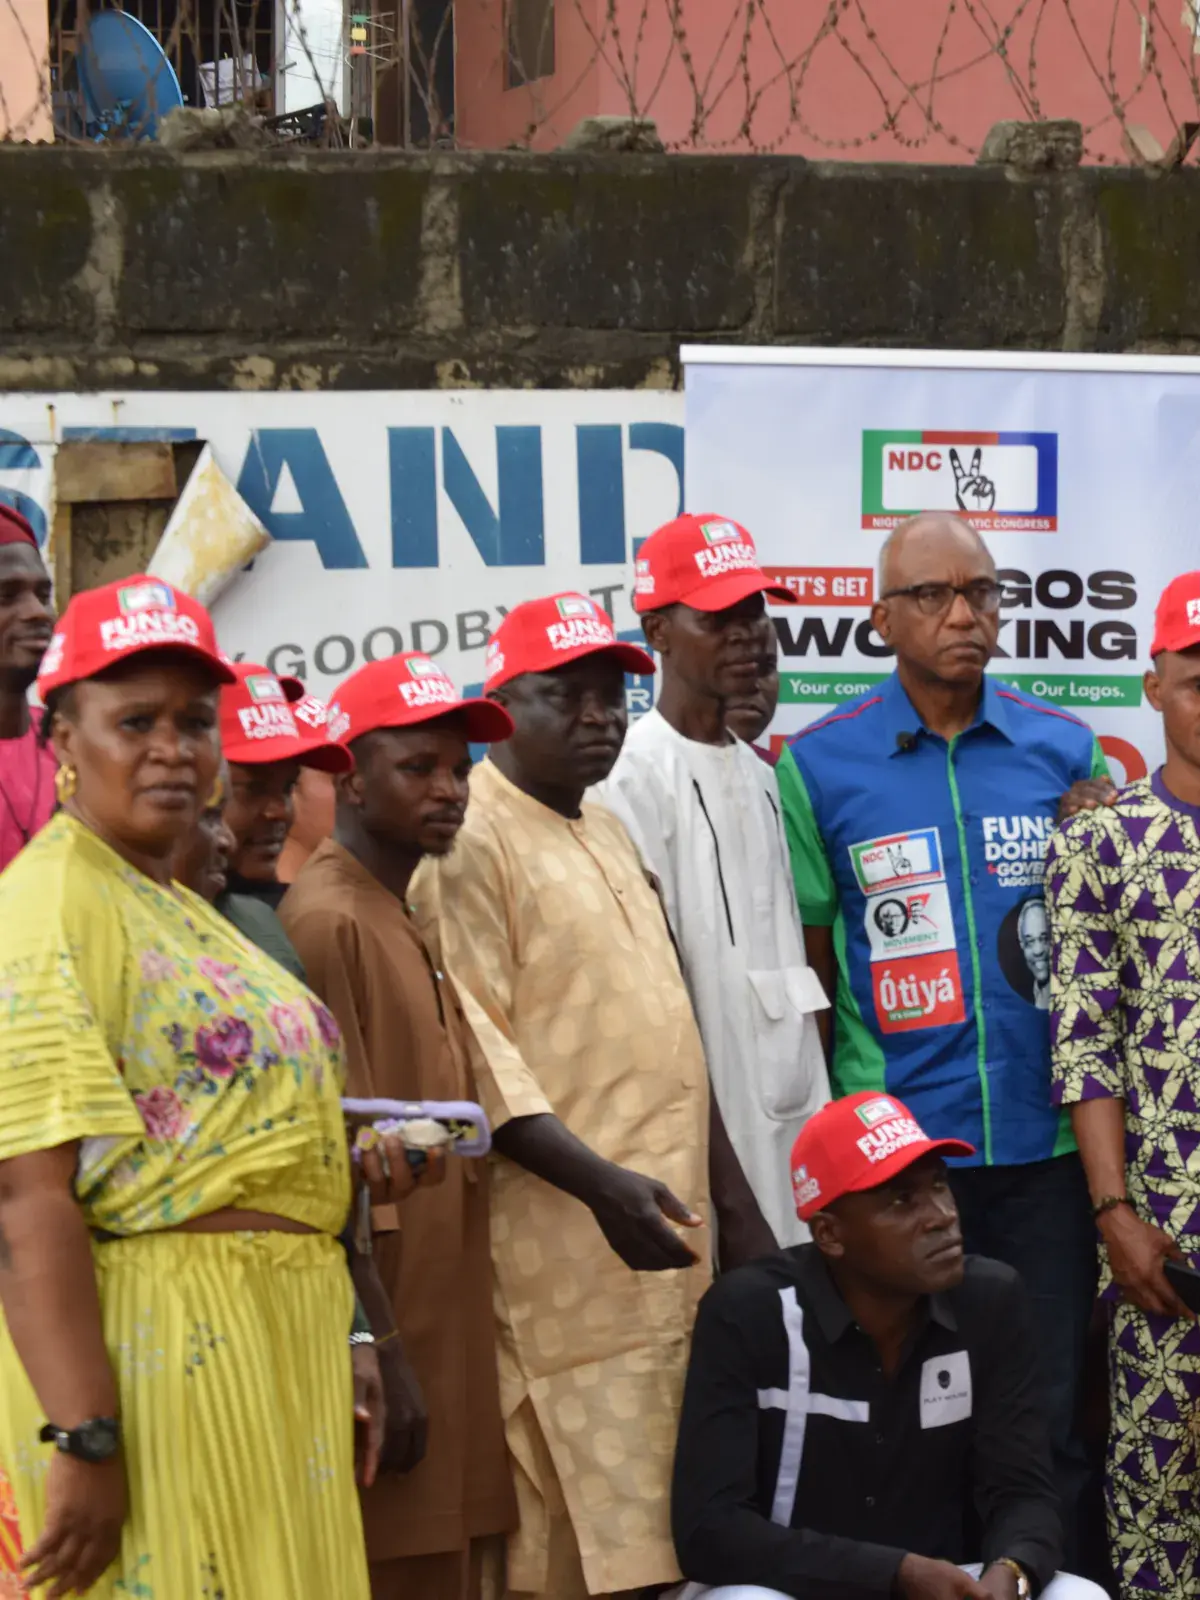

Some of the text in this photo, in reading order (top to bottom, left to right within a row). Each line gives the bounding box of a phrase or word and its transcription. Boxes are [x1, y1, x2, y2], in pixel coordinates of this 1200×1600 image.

[888, 451, 942, 471] NDC
[993, 519, 1050, 530] CONGRESS
[832, 576, 868, 597] GET
[100, 611, 199, 646] FUNSO
[789, 679, 829, 695] Your
[1031, 681, 1066, 697] Our
[1069, 682, 1125, 702] Lagos.
[862, 850, 884, 865] NDC
[882, 931, 938, 948] MOVEMENT
